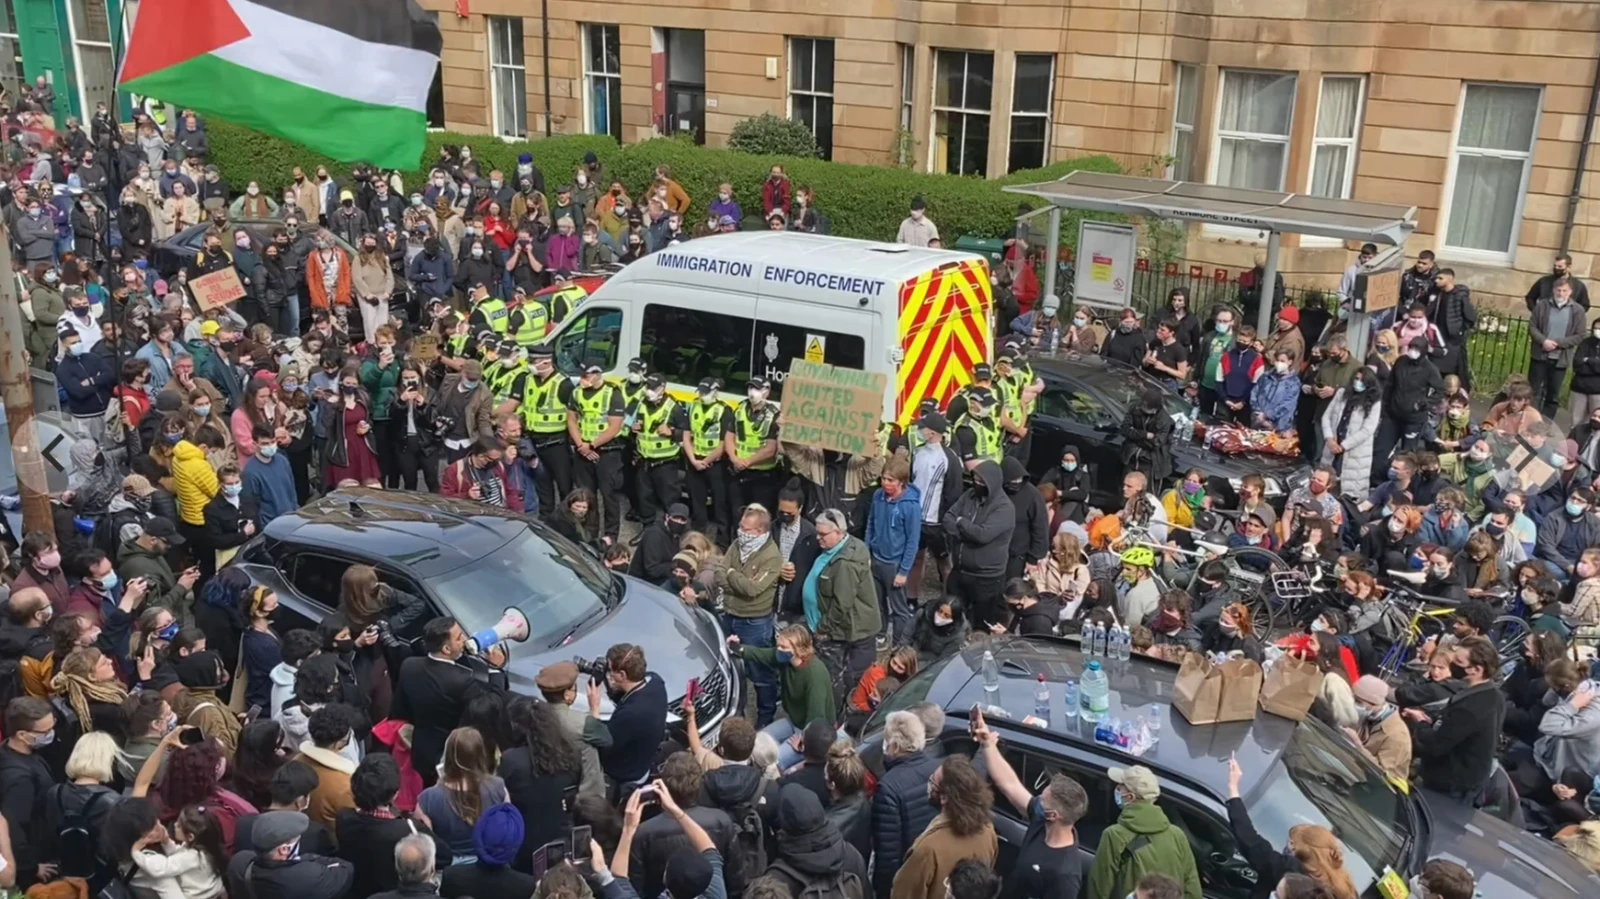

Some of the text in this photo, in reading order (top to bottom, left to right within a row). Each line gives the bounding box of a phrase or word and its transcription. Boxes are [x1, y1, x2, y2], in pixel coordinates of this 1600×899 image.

[656, 252, 885, 296] IMMIGRATION ENFORCEMENT
[765, 365, 790, 382] Ho
[792, 381, 855, 407] UNITED
[786, 400, 875, 433] AGAINST
[782, 421, 866, 453] EVICTION
